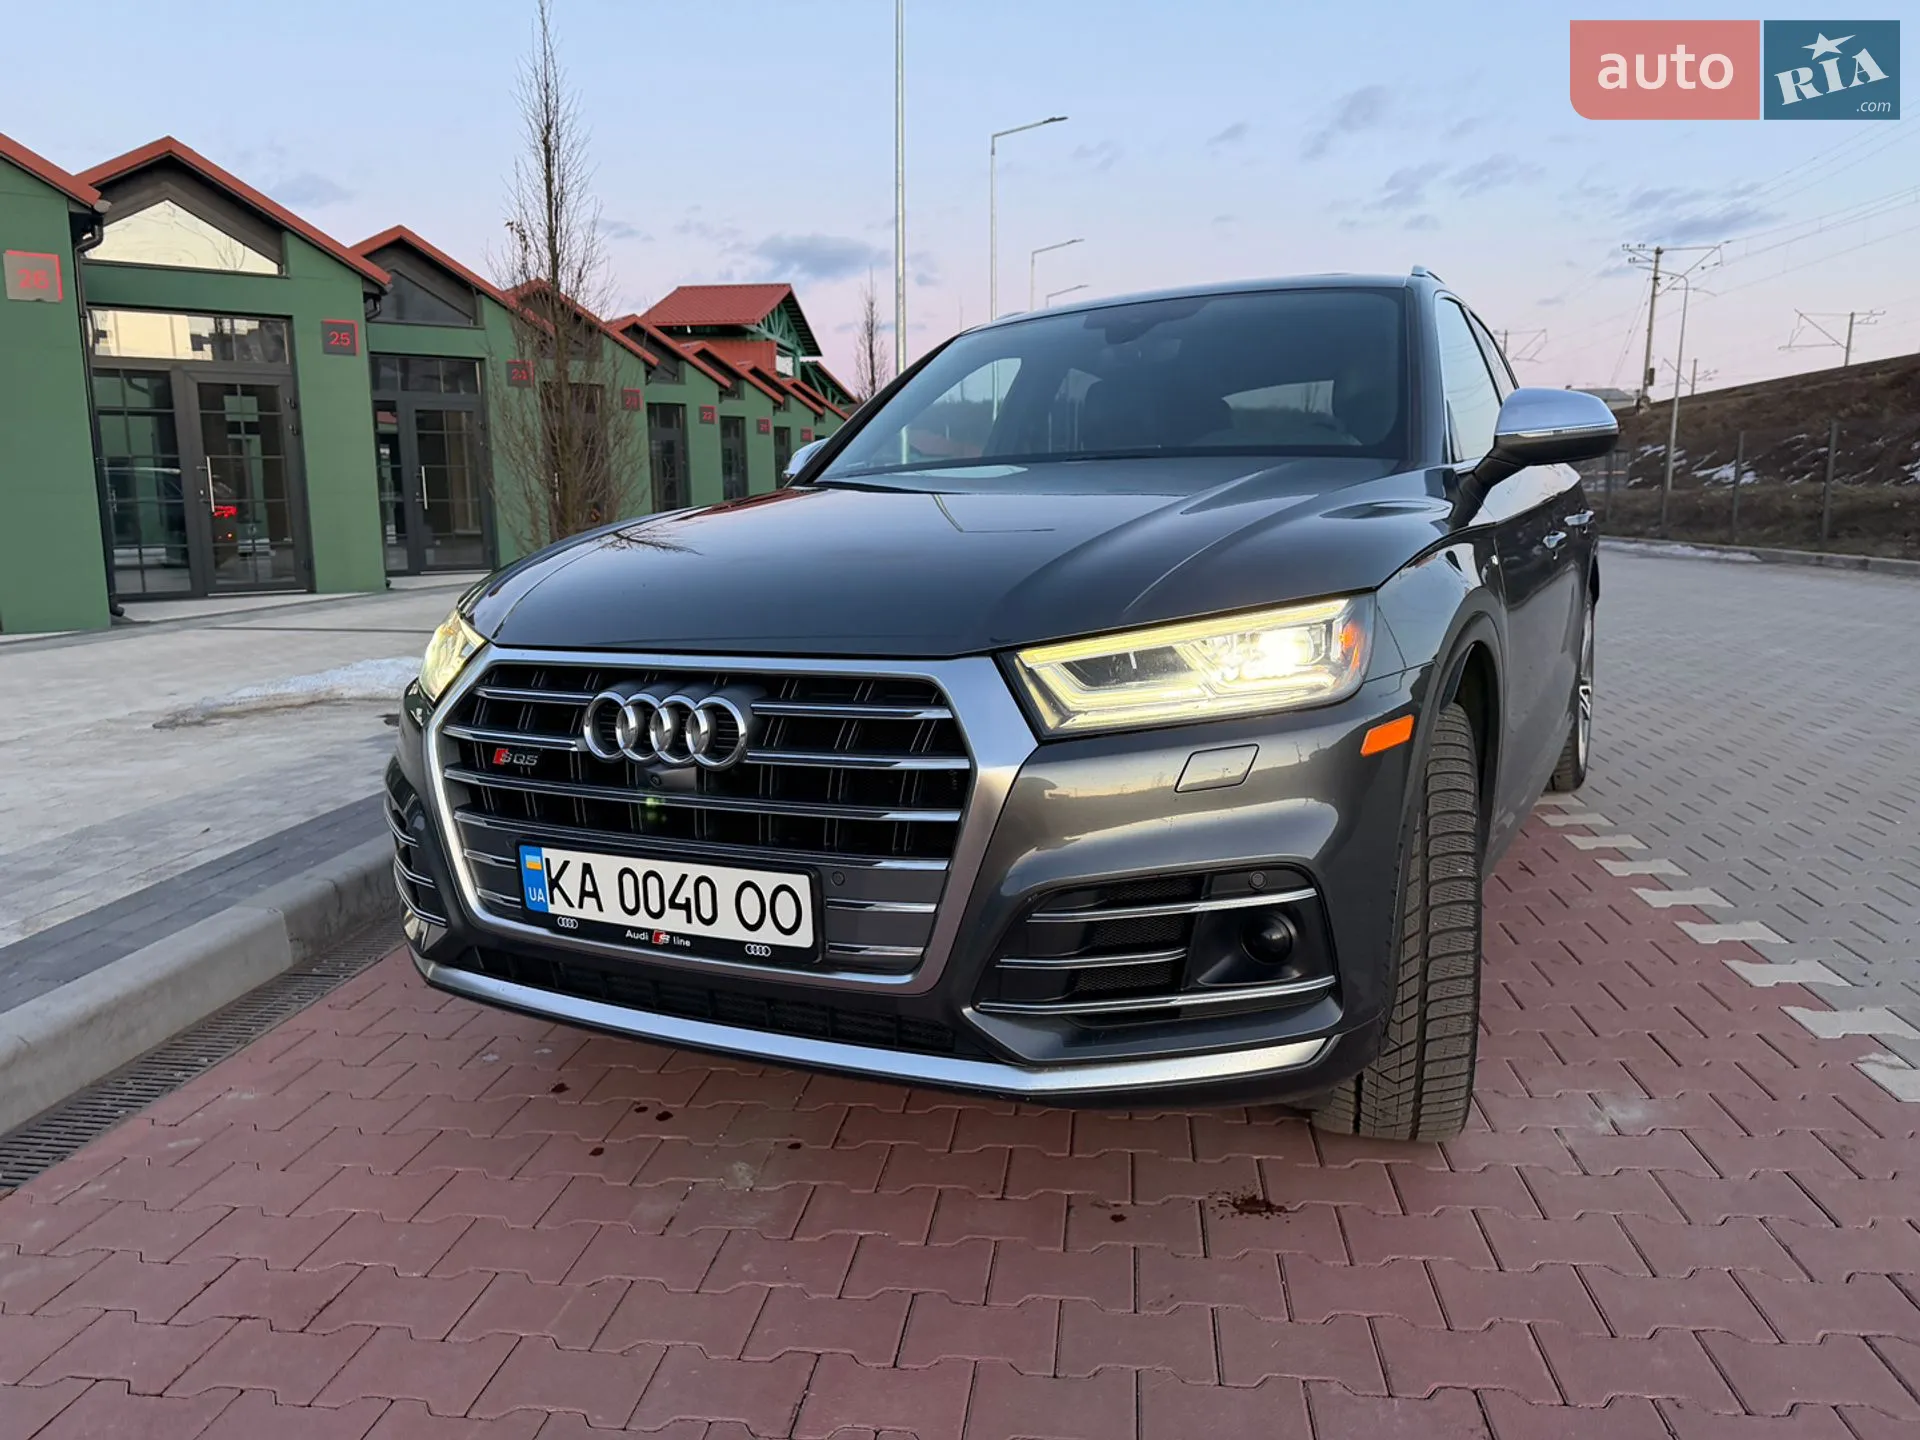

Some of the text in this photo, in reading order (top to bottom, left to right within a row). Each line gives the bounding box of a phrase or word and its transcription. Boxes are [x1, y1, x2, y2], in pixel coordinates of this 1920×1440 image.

[17, 268, 50, 290] 26
[329, 331, 351, 347] 25
[528, 886, 545, 903] UA
[545, 857, 604, 913] KA
[617, 867, 719, 926] 0040
[625, 929, 649, 941] Audi
[673, 935, 691, 947] line
